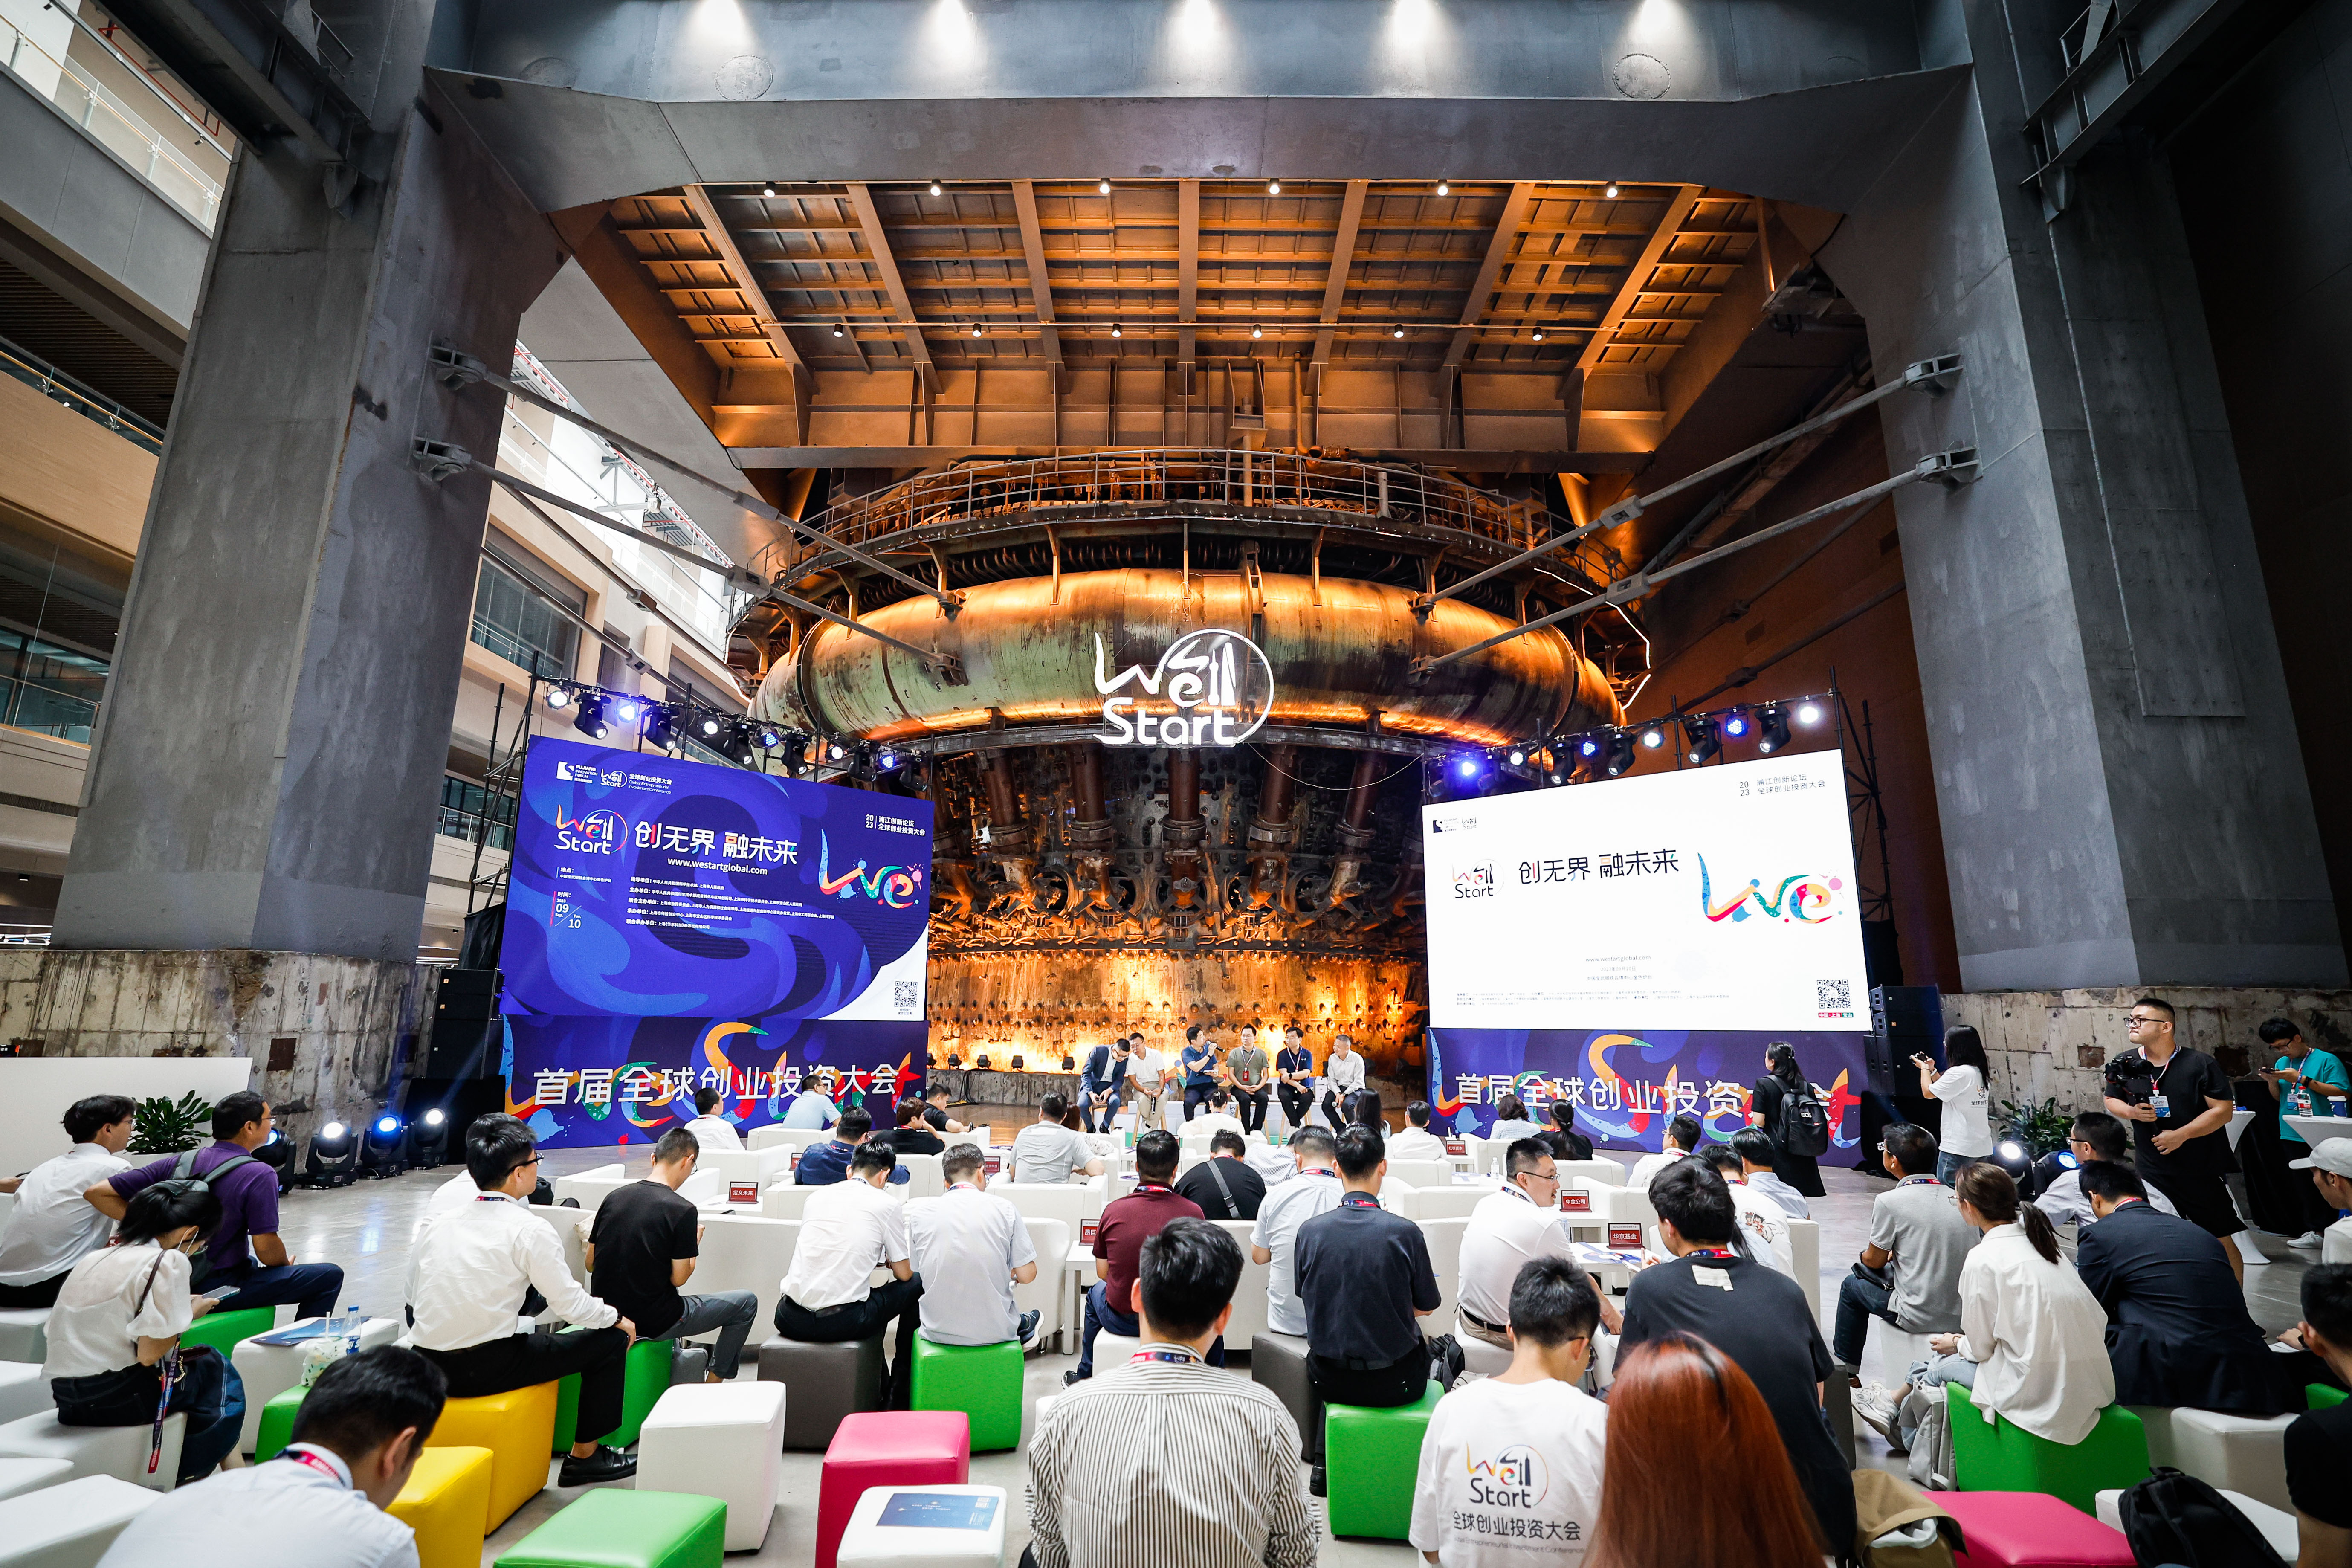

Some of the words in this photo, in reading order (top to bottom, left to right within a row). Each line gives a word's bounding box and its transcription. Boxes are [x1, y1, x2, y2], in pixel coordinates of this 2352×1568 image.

[1092, 697, 1235, 745] Start
[600, 778, 621, 788] Start
[629, 773, 672, 785] 全球创业投资大会
[1757, 774, 1807, 785] 浦江创新论坛
[1758, 780, 1825, 794] 全球创业投资大会
[878, 823, 926, 836] 全球创业投资大会
[879, 816, 915, 827] 浦江创新论坛
[554, 830, 611, 855] Start
[634, 821, 716, 855] 创无界
[723, 832, 798, 865] 融未来
[667, 857, 768, 875] www.westartglobal.com
[1519, 857, 1591, 884] 创无界
[1599, 849, 1679, 878] 融未来
[1454, 883, 1494, 898] Start
[556, 903, 569, 913] 09
[568, 919, 581, 929] 10
[533, 1063, 899, 1106] 首届全球创业投资大会
[1455, 1072, 1832, 1121] 首届全球创业投资
[1468, 1478, 1532, 1509] Start
[1453, 1511, 1581, 1541] 全球创业投资大会
